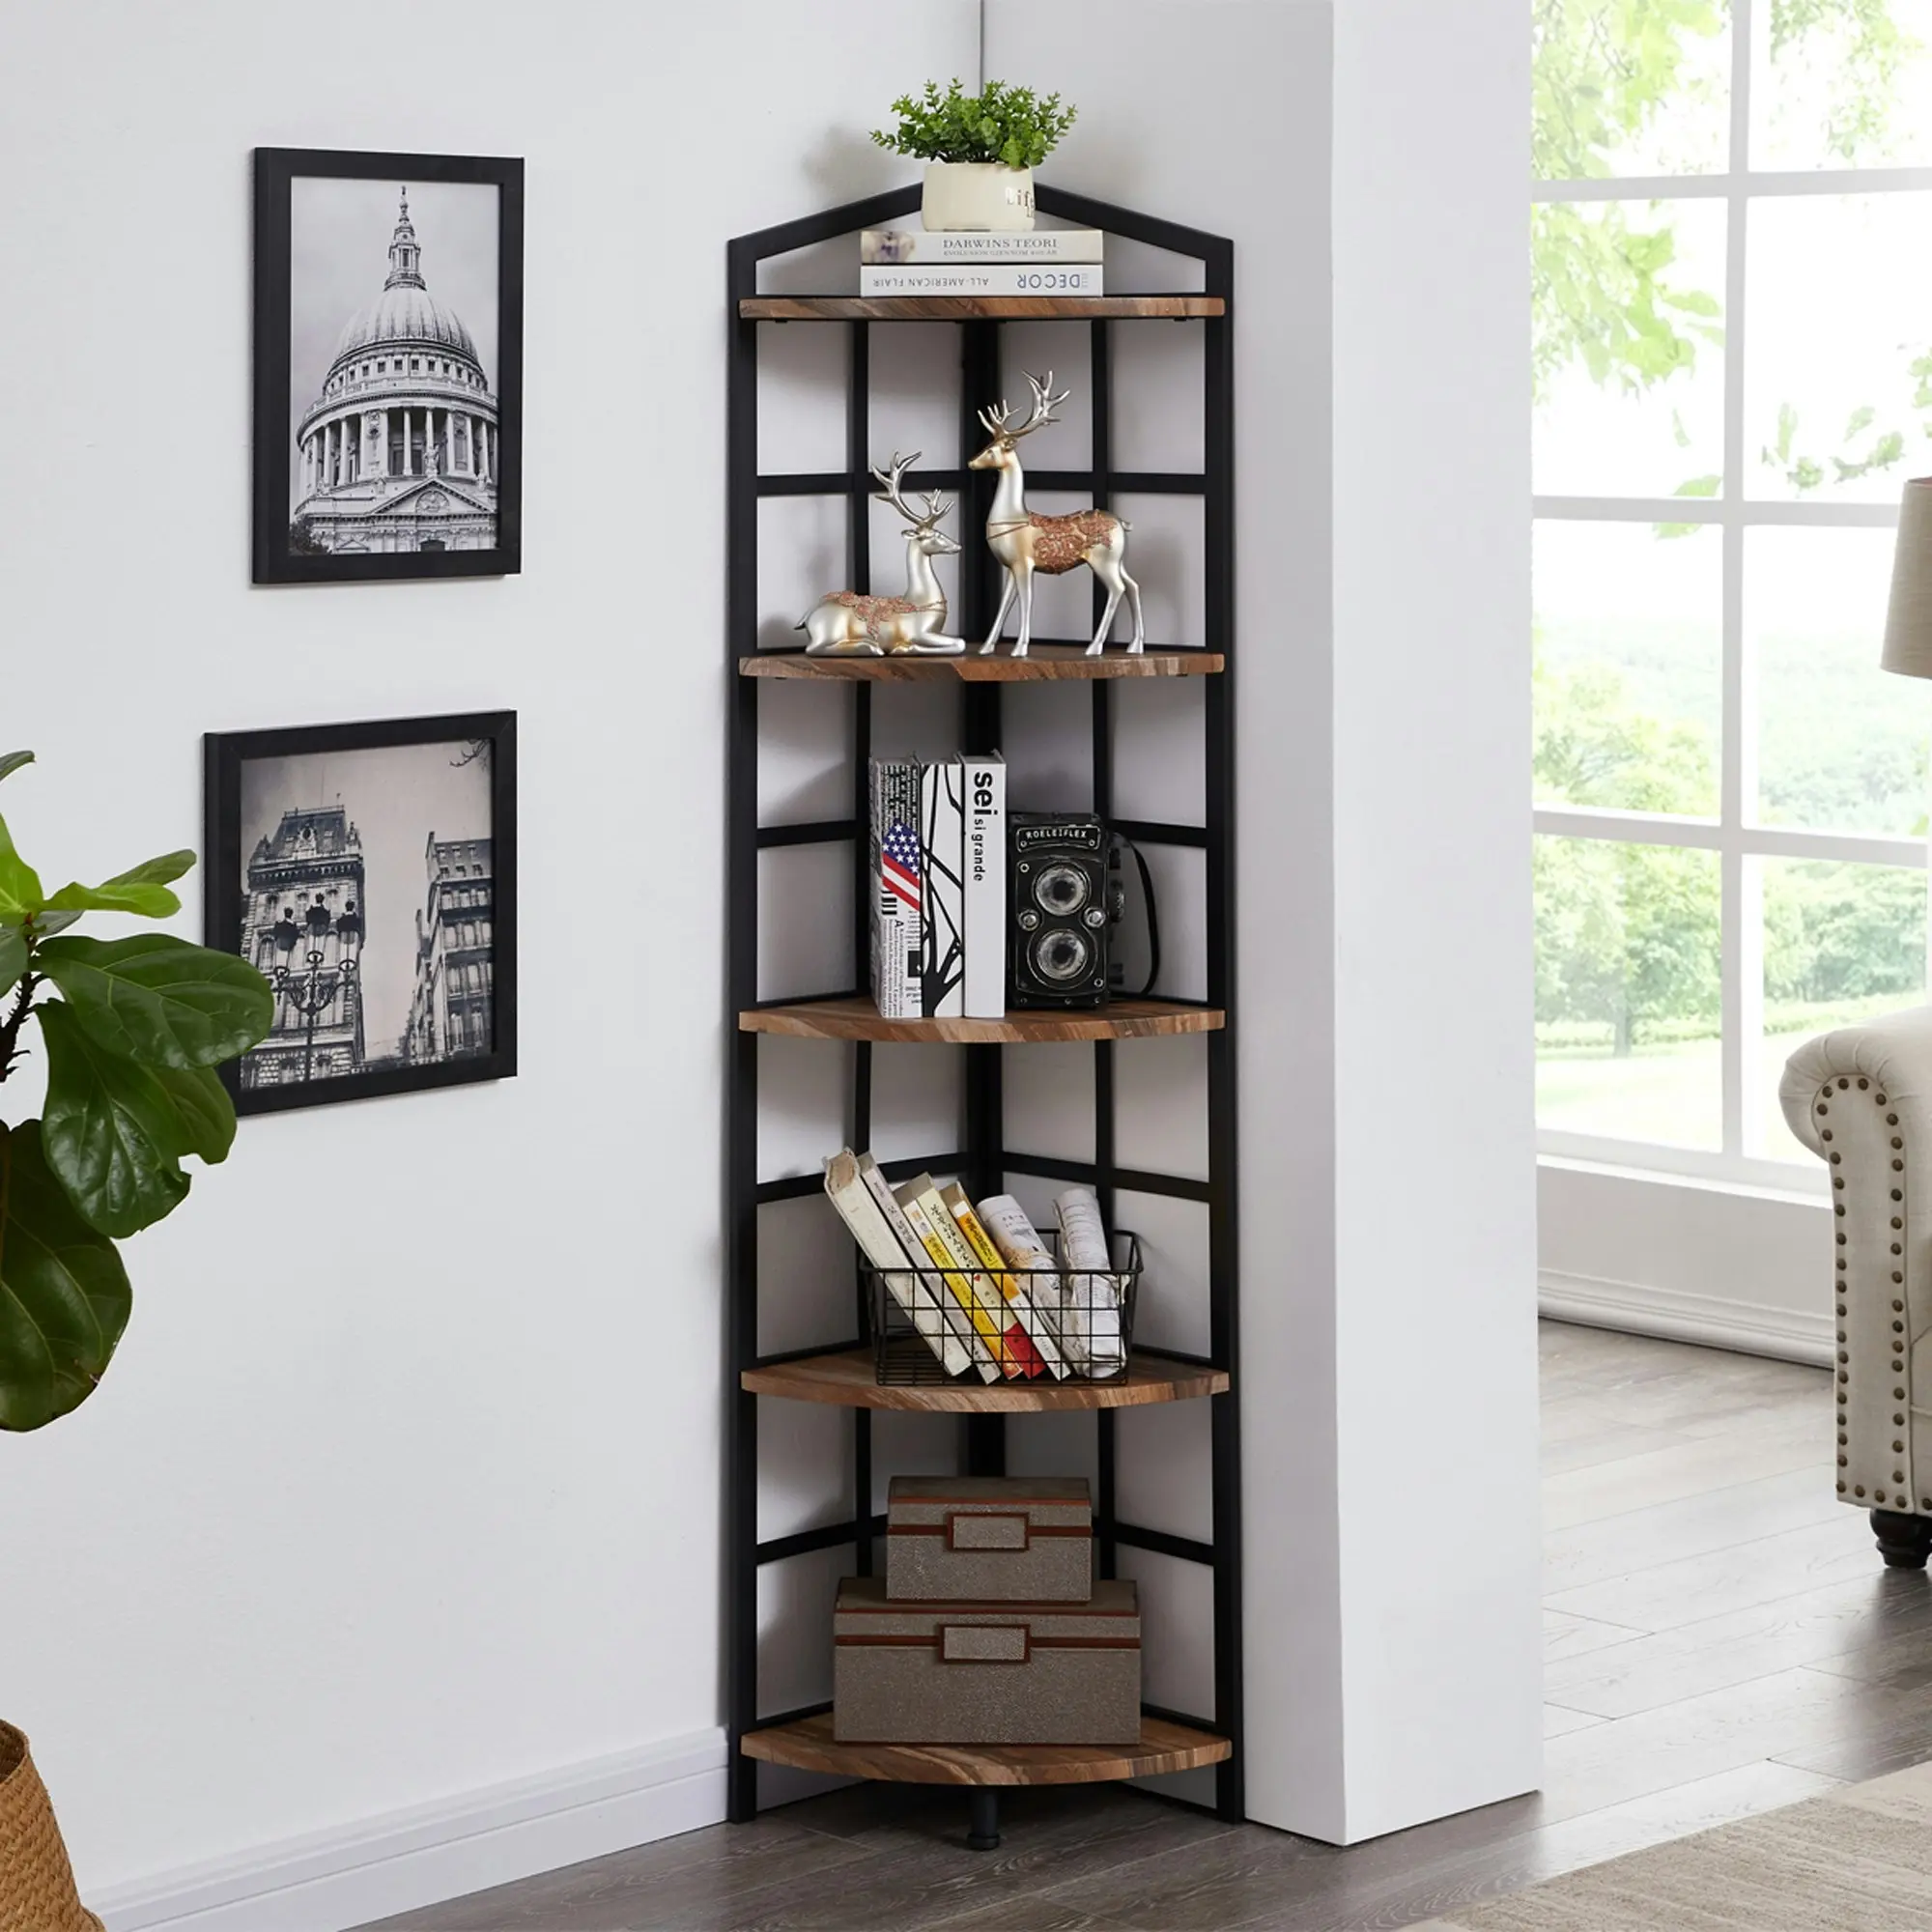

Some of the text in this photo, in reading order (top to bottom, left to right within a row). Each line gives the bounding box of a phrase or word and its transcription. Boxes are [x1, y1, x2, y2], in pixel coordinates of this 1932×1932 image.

[943, 239, 1058, 248] DARWINS TEORI
[873, 277, 904, 287] FLAIR
[909, 277, 989, 287] ALL-AMERICAN
[1017, 274, 1080, 289] DECOR
[974, 772, 999, 815] sei
[971, 834, 986, 882] grande
